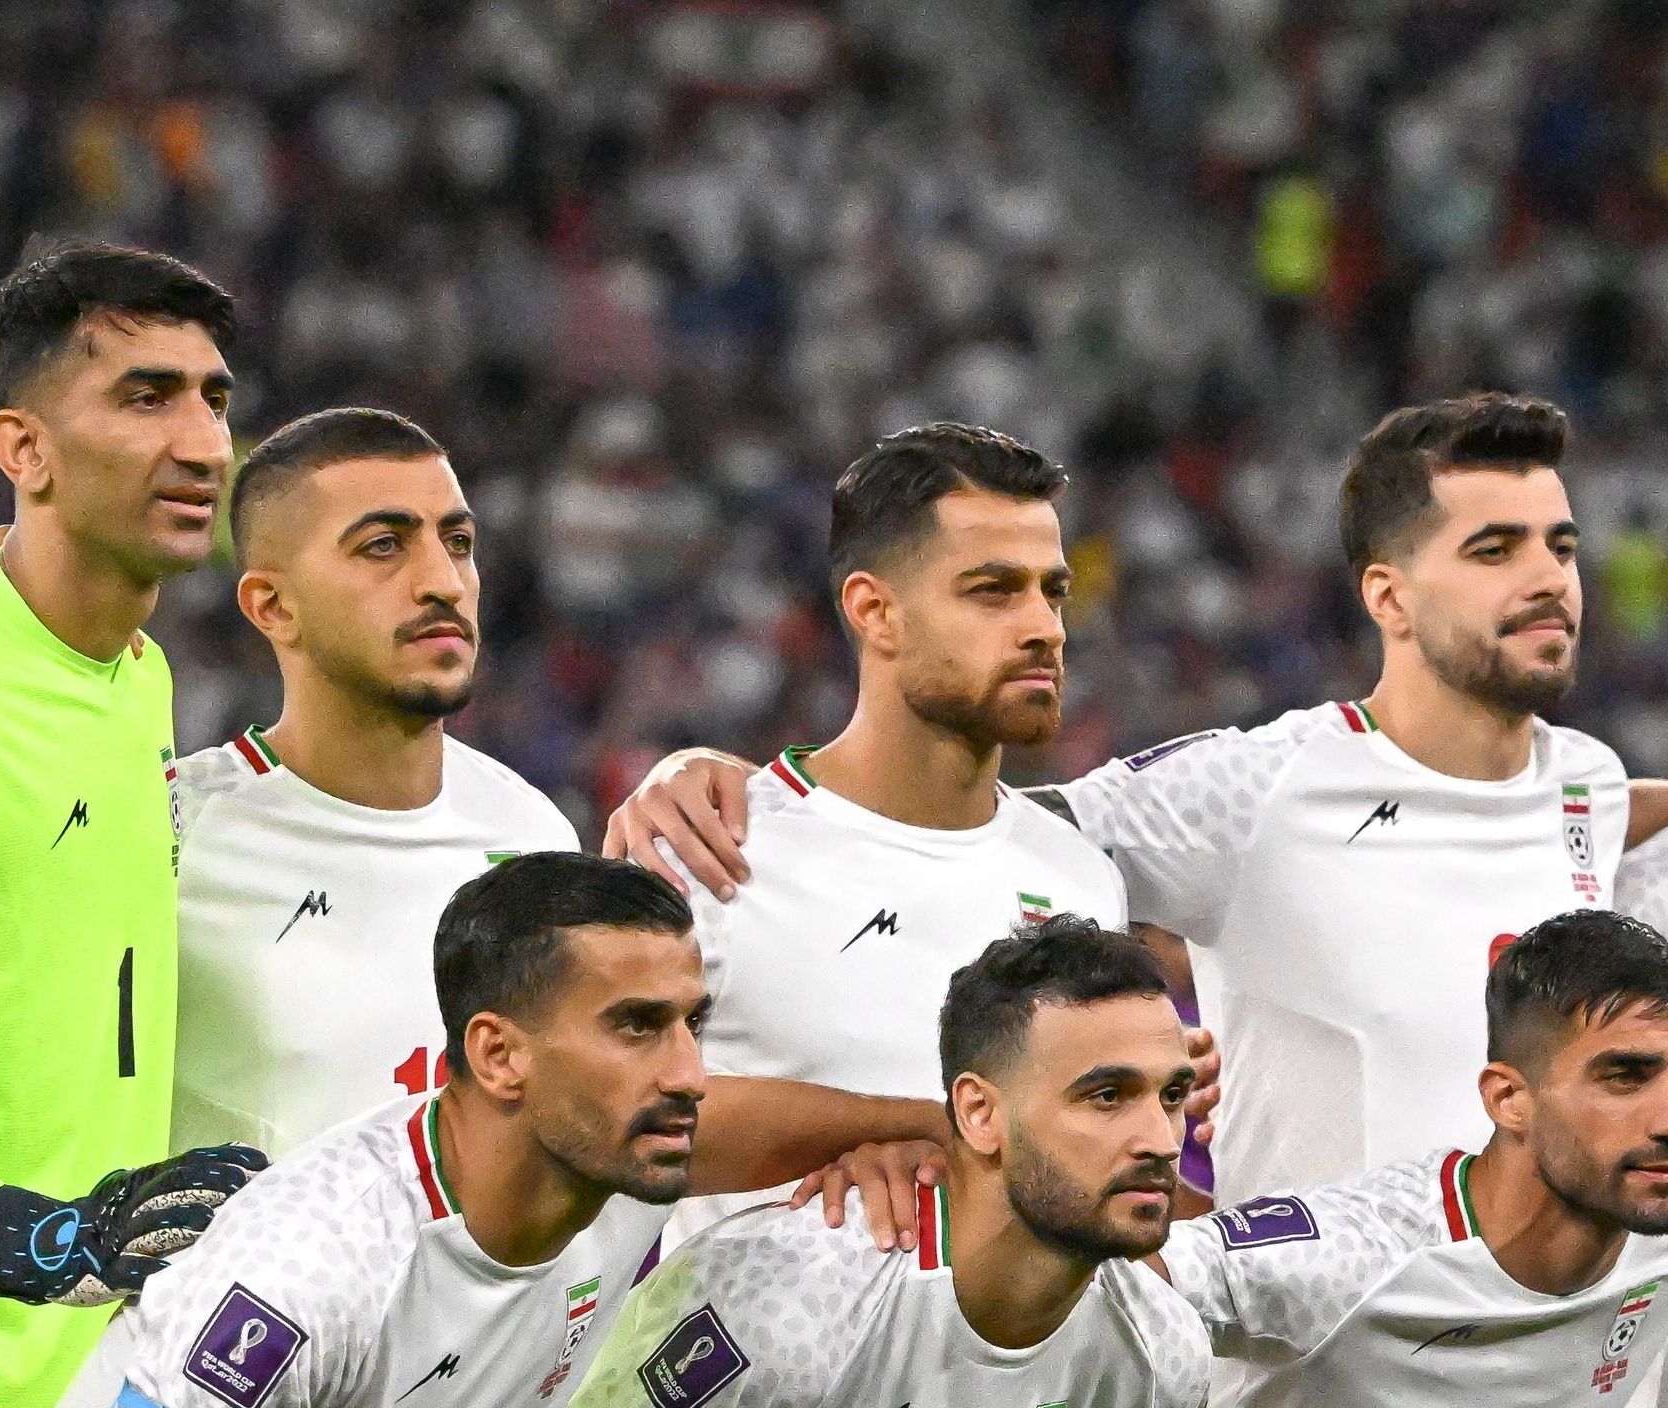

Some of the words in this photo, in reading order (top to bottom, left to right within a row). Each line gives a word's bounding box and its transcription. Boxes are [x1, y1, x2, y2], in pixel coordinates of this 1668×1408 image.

[117, 947, 136, 1078] 1
[217, 1358, 242, 1379] WORLD
[240, 1375, 256, 1388] CUP
